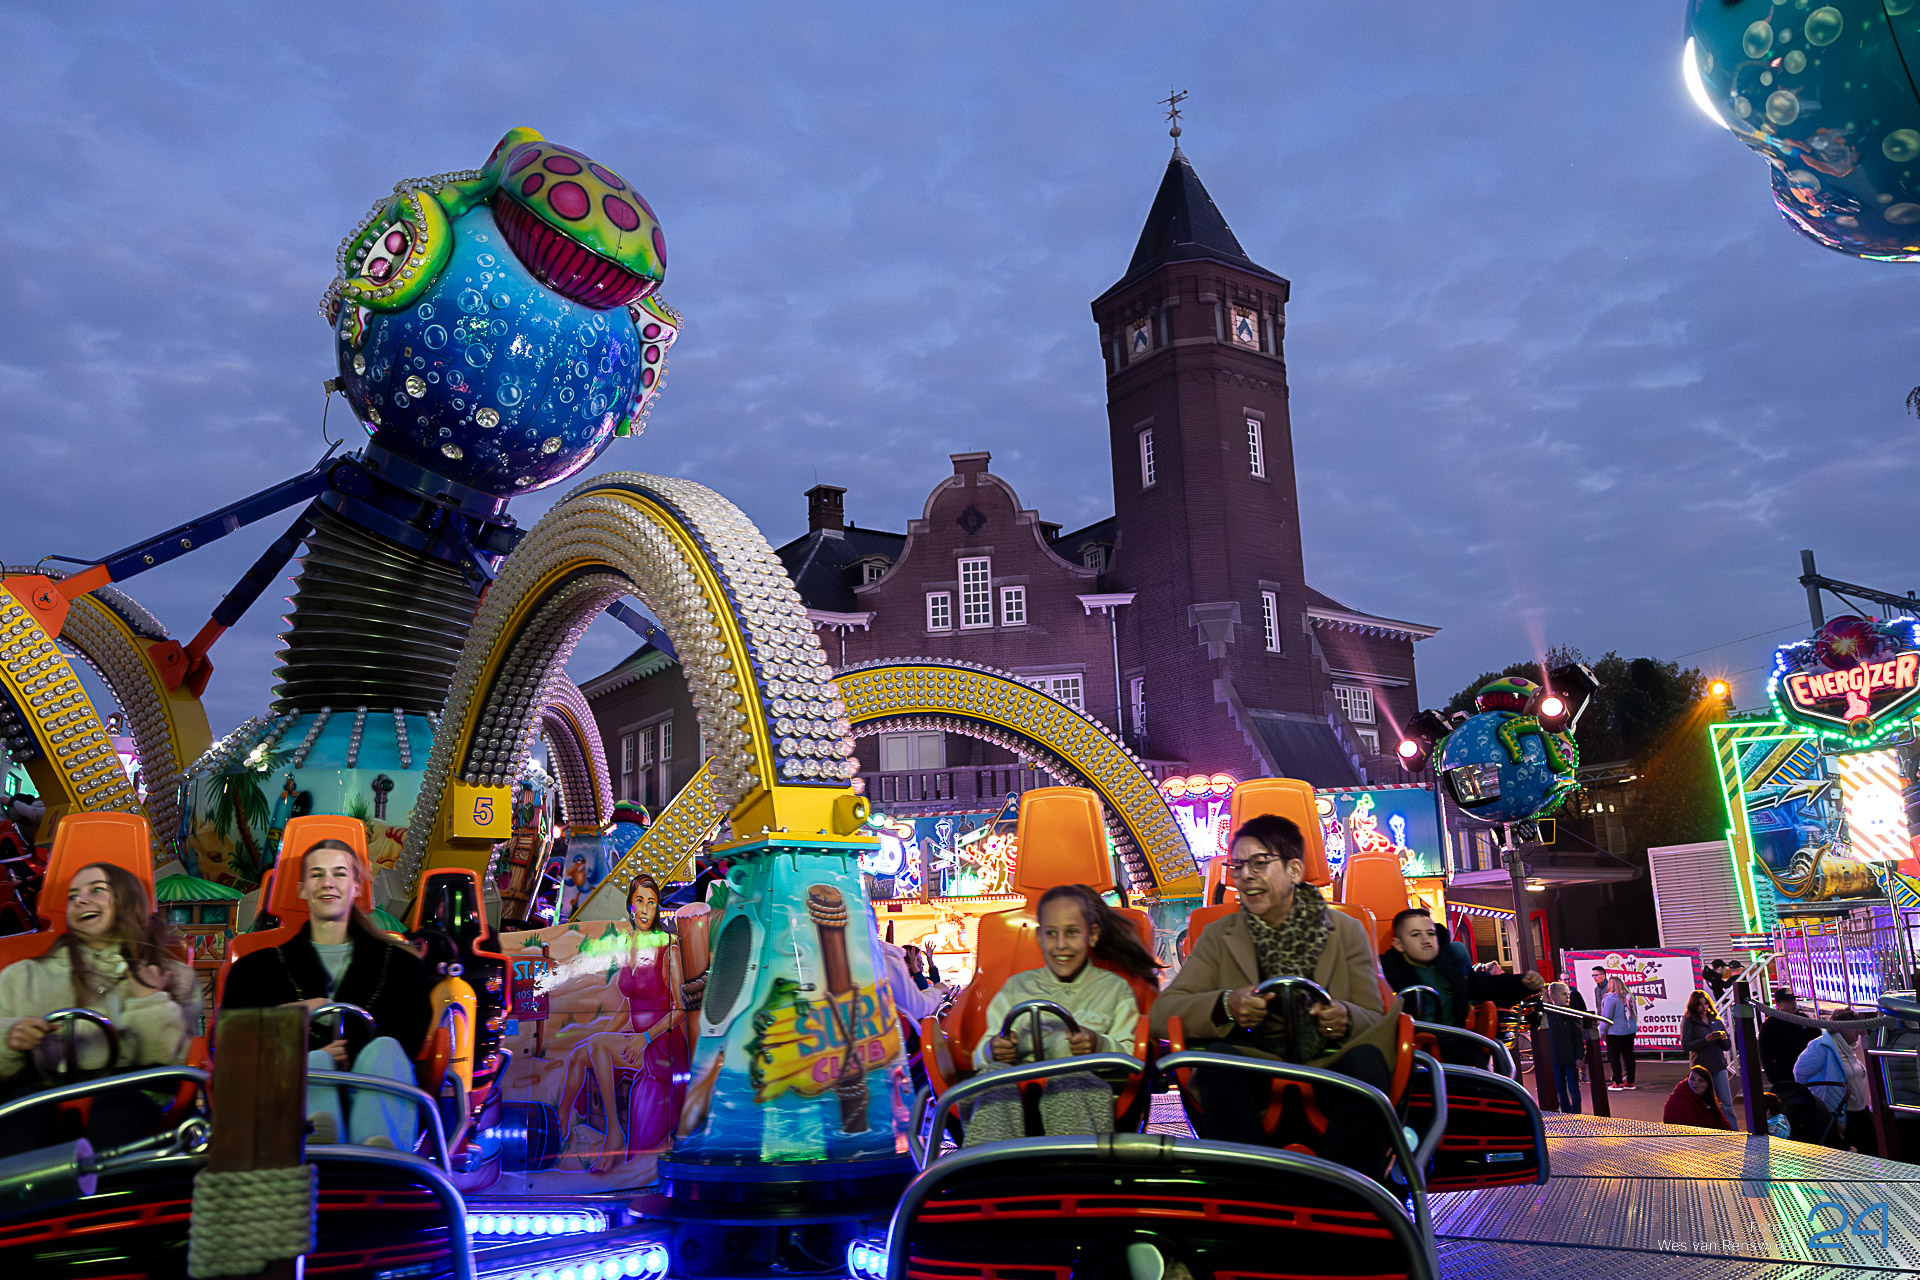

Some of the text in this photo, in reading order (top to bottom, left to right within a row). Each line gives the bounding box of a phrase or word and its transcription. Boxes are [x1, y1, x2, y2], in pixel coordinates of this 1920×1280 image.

[1790, 654, 1918, 706] ENERGIZER
[473, 797, 494, 826] 5
[1628, 983, 1663, 995] WEERT
[1643, 1015, 1683, 1023] GROOTST
[1637, 1025, 1678, 1033] KOOPSTE!
[1633, 1037, 1682, 1046] MISWEERT.
